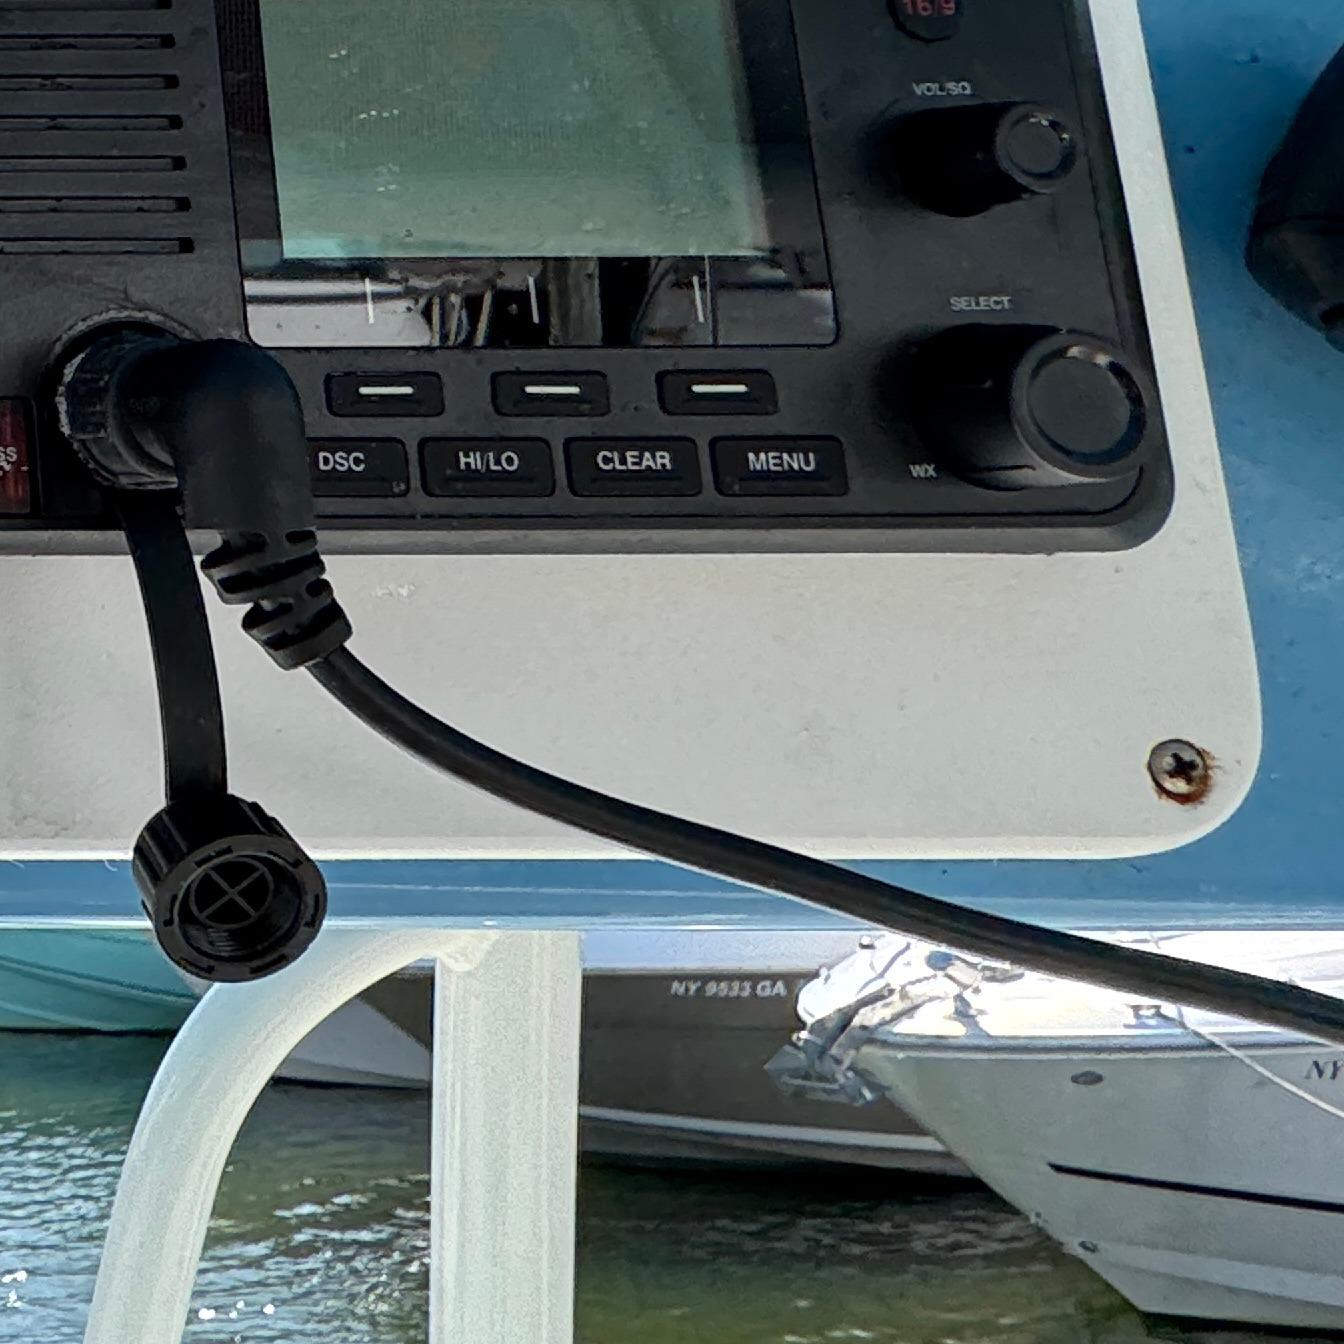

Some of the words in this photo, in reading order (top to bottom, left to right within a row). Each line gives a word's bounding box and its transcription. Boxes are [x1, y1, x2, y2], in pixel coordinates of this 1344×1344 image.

[949, 295, 1012, 312] SELECT
[318, 451, 366, 472] DSC
[458, 450, 520, 473] HI/LO
[596, 450, 672, 471] CLEAR
[747, 451, 816, 473] MENU
[908, 463, 938, 479] WX
[671, 979, 701, 997] NY
